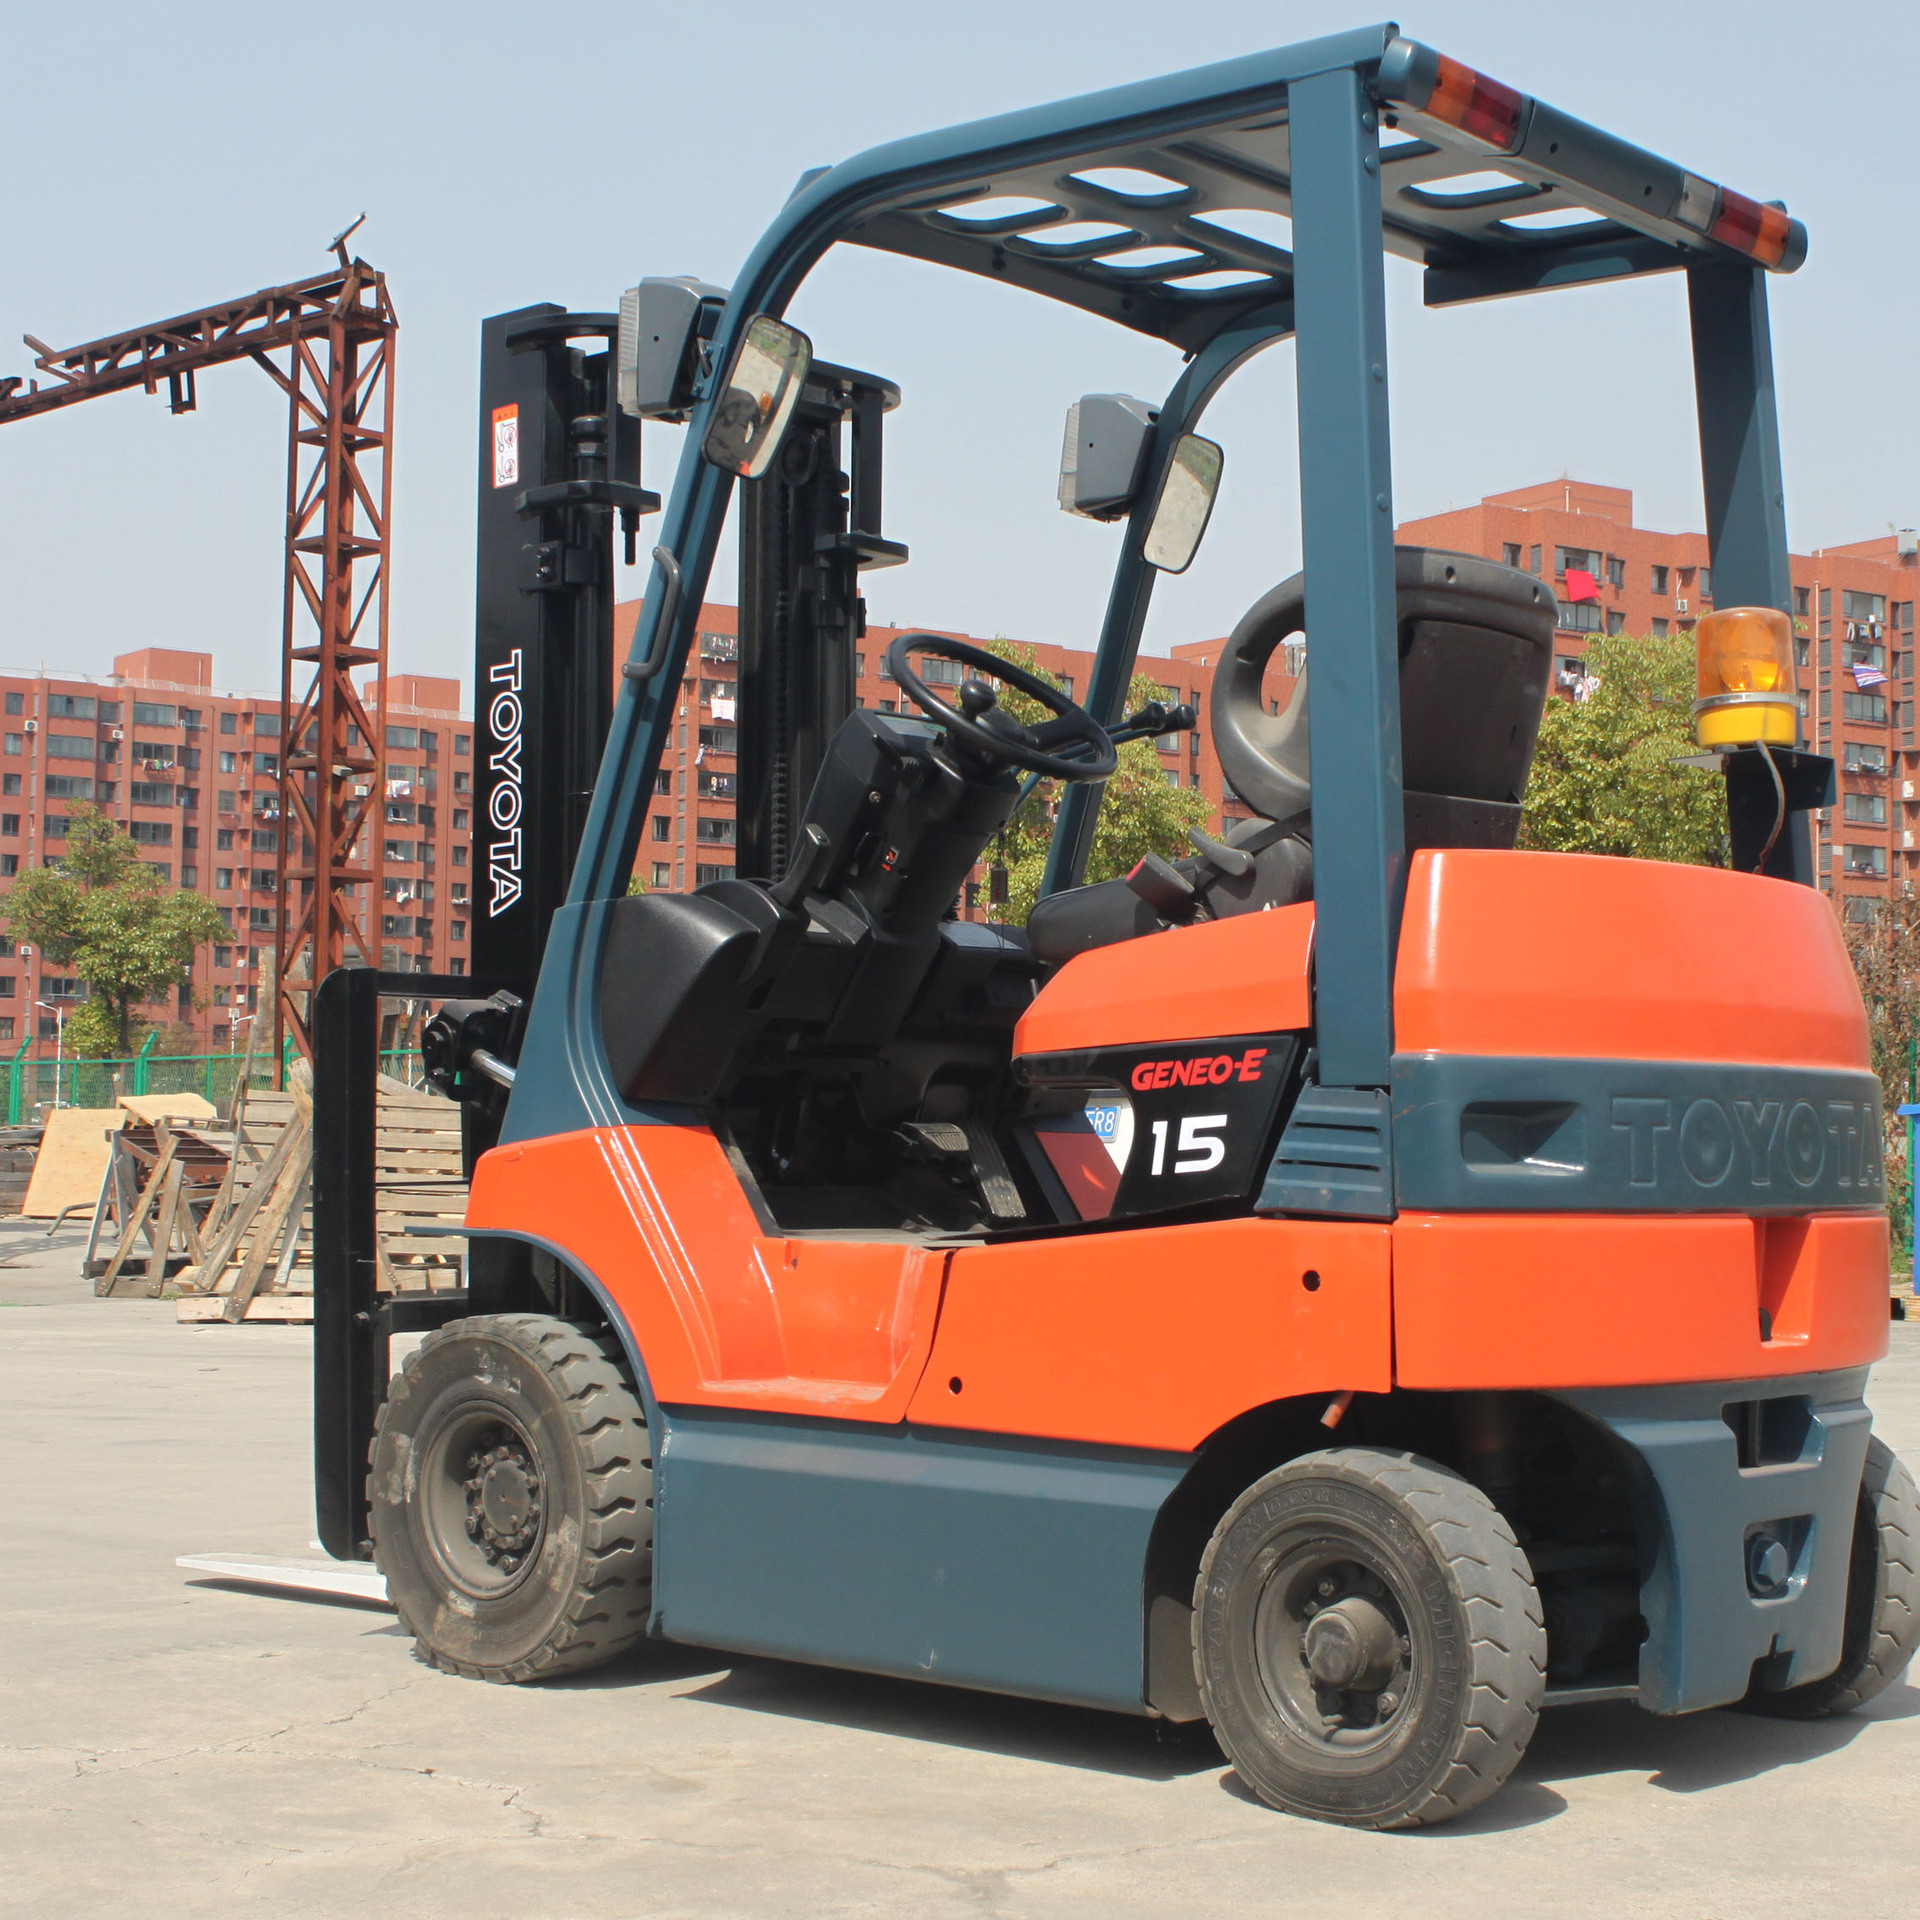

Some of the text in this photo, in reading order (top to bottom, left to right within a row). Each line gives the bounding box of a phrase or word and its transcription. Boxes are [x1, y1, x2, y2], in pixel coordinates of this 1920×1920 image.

[489, 649, 522, 917] TOYOTA
[1131, 1048, 1268, 1092] GENEO-E
[1150, 1113, 1228, 1177] 15
[1611, 1096, 1882, 1187] TOYOTA
